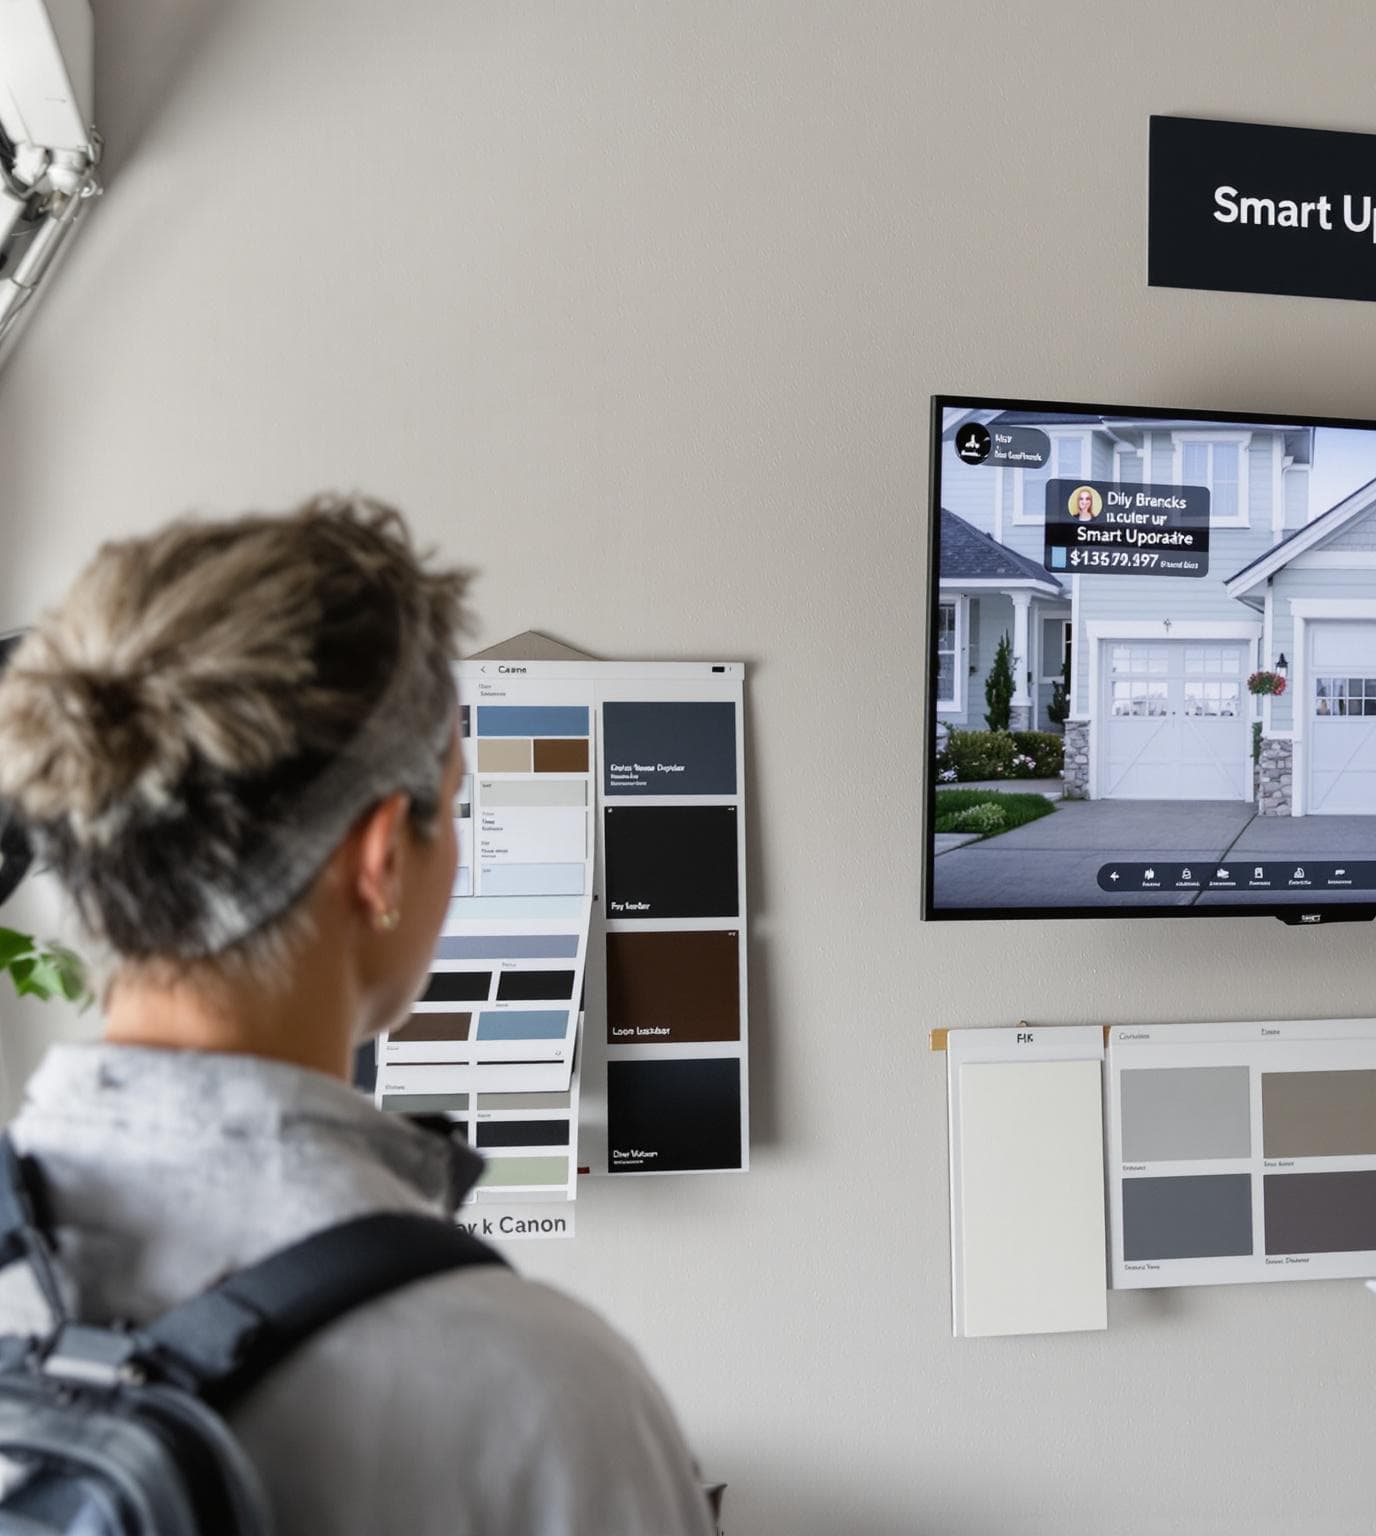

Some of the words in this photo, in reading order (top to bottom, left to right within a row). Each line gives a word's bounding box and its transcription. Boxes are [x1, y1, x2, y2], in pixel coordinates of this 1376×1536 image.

[1213, 185, 1332, 230] Smart
[1077, 526, 1122, 542] Smart
[482, 1218, 493, 1235] k
[499, 1216, 566, 1233] Canon
